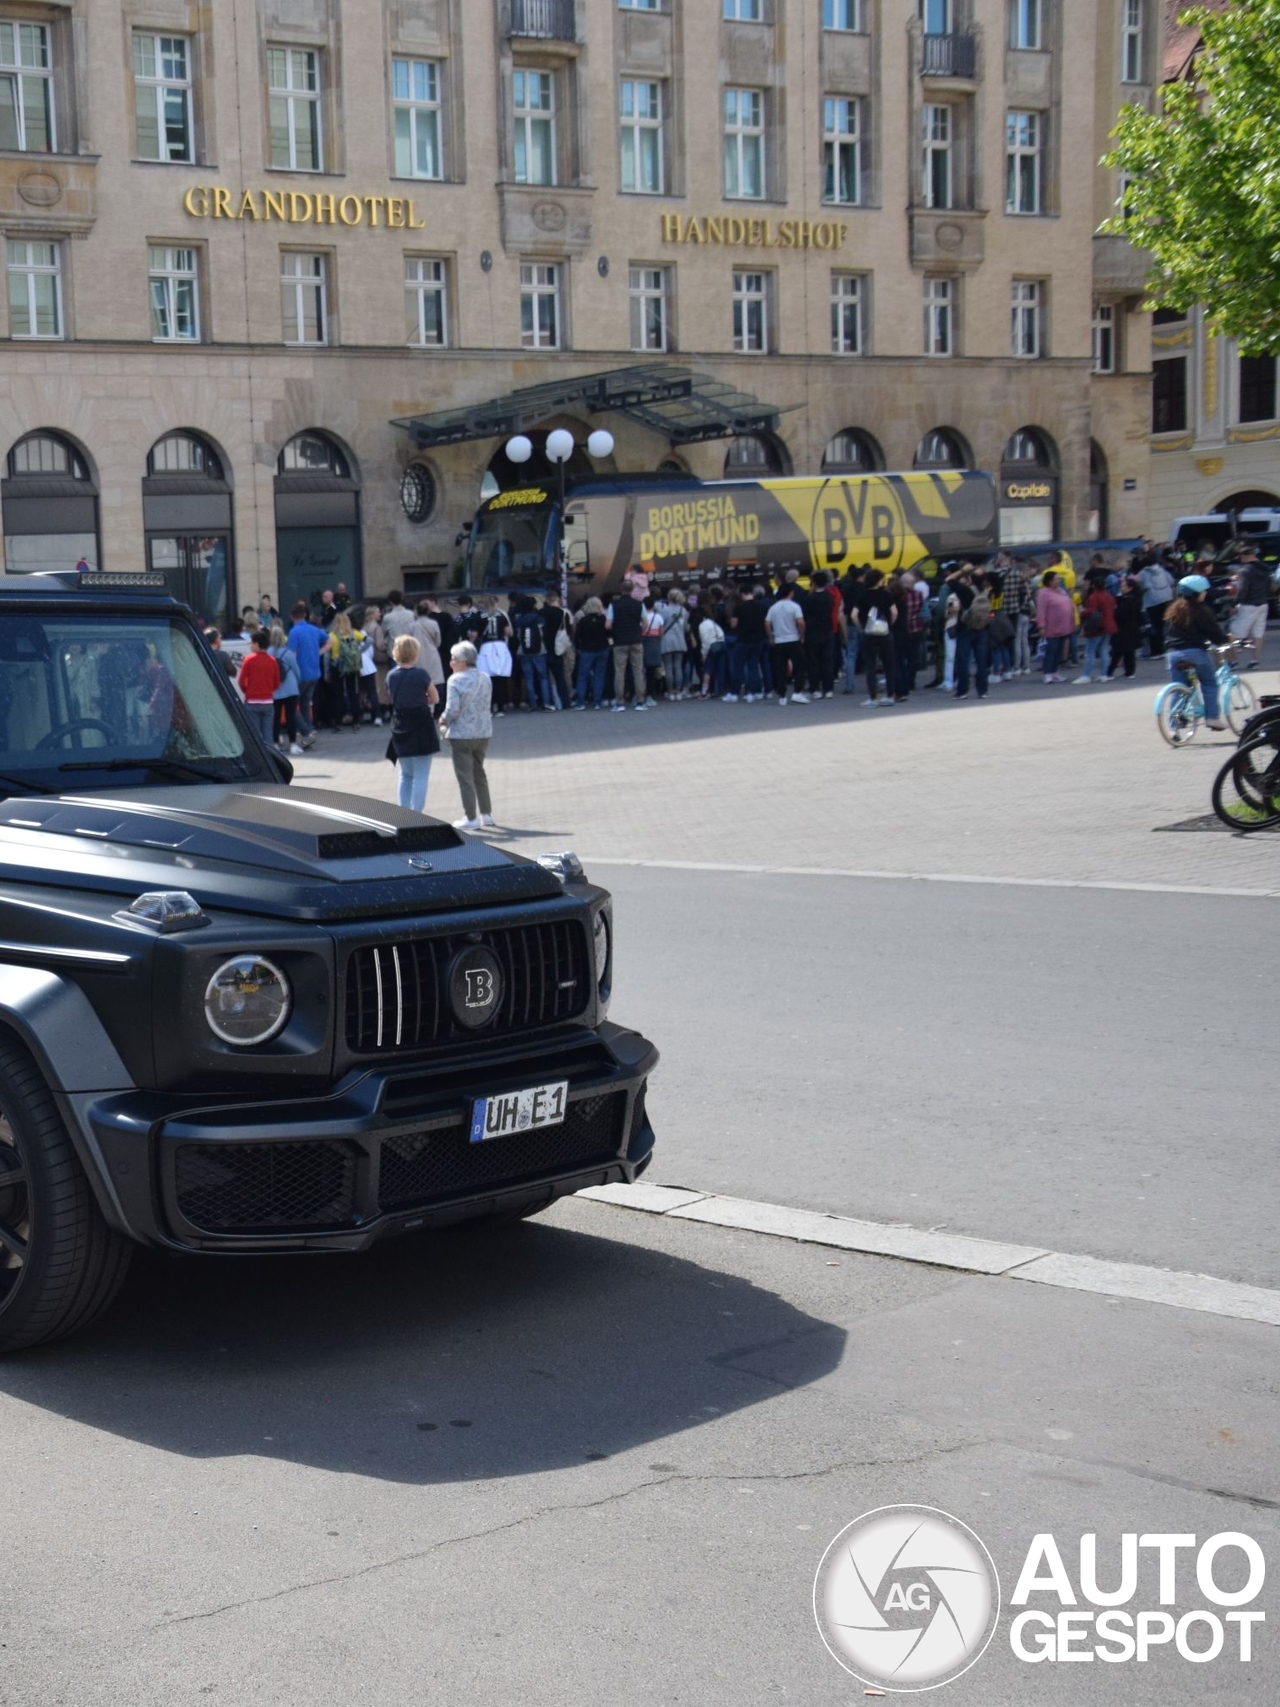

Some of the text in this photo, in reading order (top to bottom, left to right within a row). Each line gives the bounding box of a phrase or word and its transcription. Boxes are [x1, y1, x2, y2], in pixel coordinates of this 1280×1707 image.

[183, 186, 426, 229] GRANDHOTEL
[661, 213, 849, 250] HANDELSHOF
[488, 492, 548, 511] DORTMUND
[1007, 482, 1051, 499] Capitale
[648, 495, 736, 531] BORUSSIA
[823, 480, 895, 563] BVB
[639, 513, 760, 561] DORTMUND
[465, 968, 494, 1008] B
[475, 1125, 481, 1134] D
[485, 1096, 519, 1133] UH
